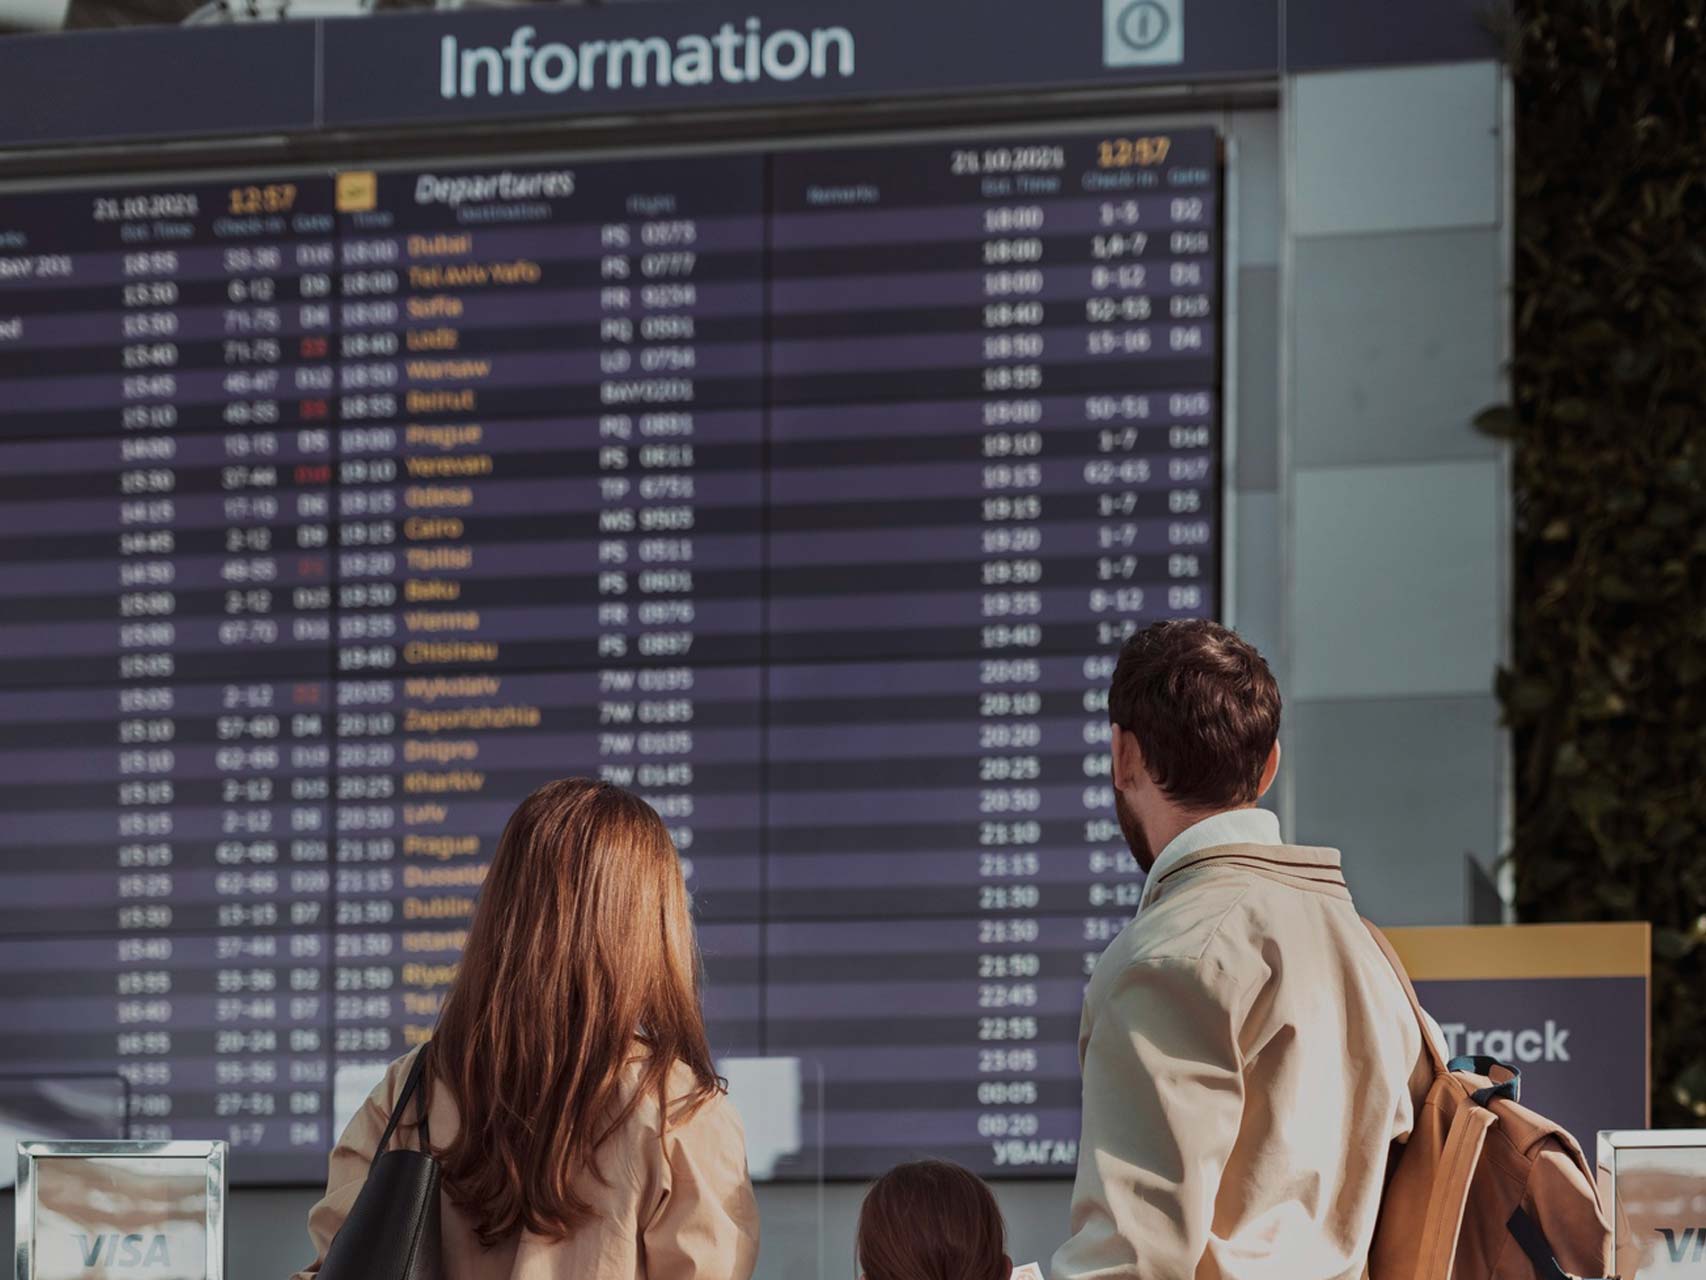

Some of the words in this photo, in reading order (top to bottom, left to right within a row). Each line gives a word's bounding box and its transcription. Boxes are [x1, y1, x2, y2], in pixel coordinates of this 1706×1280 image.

[441, 17, 855, 99] Information
[1098, 136, 1170, 167] 12:57
[229, 184, 296, 214] 12:57
[415, 171, 575, 206] Departures
[1441, 1020, 1570, 1063] Track
[72, 1233, 171, 1267] VISA
[1654, 1227, 1706, 1263] VI
